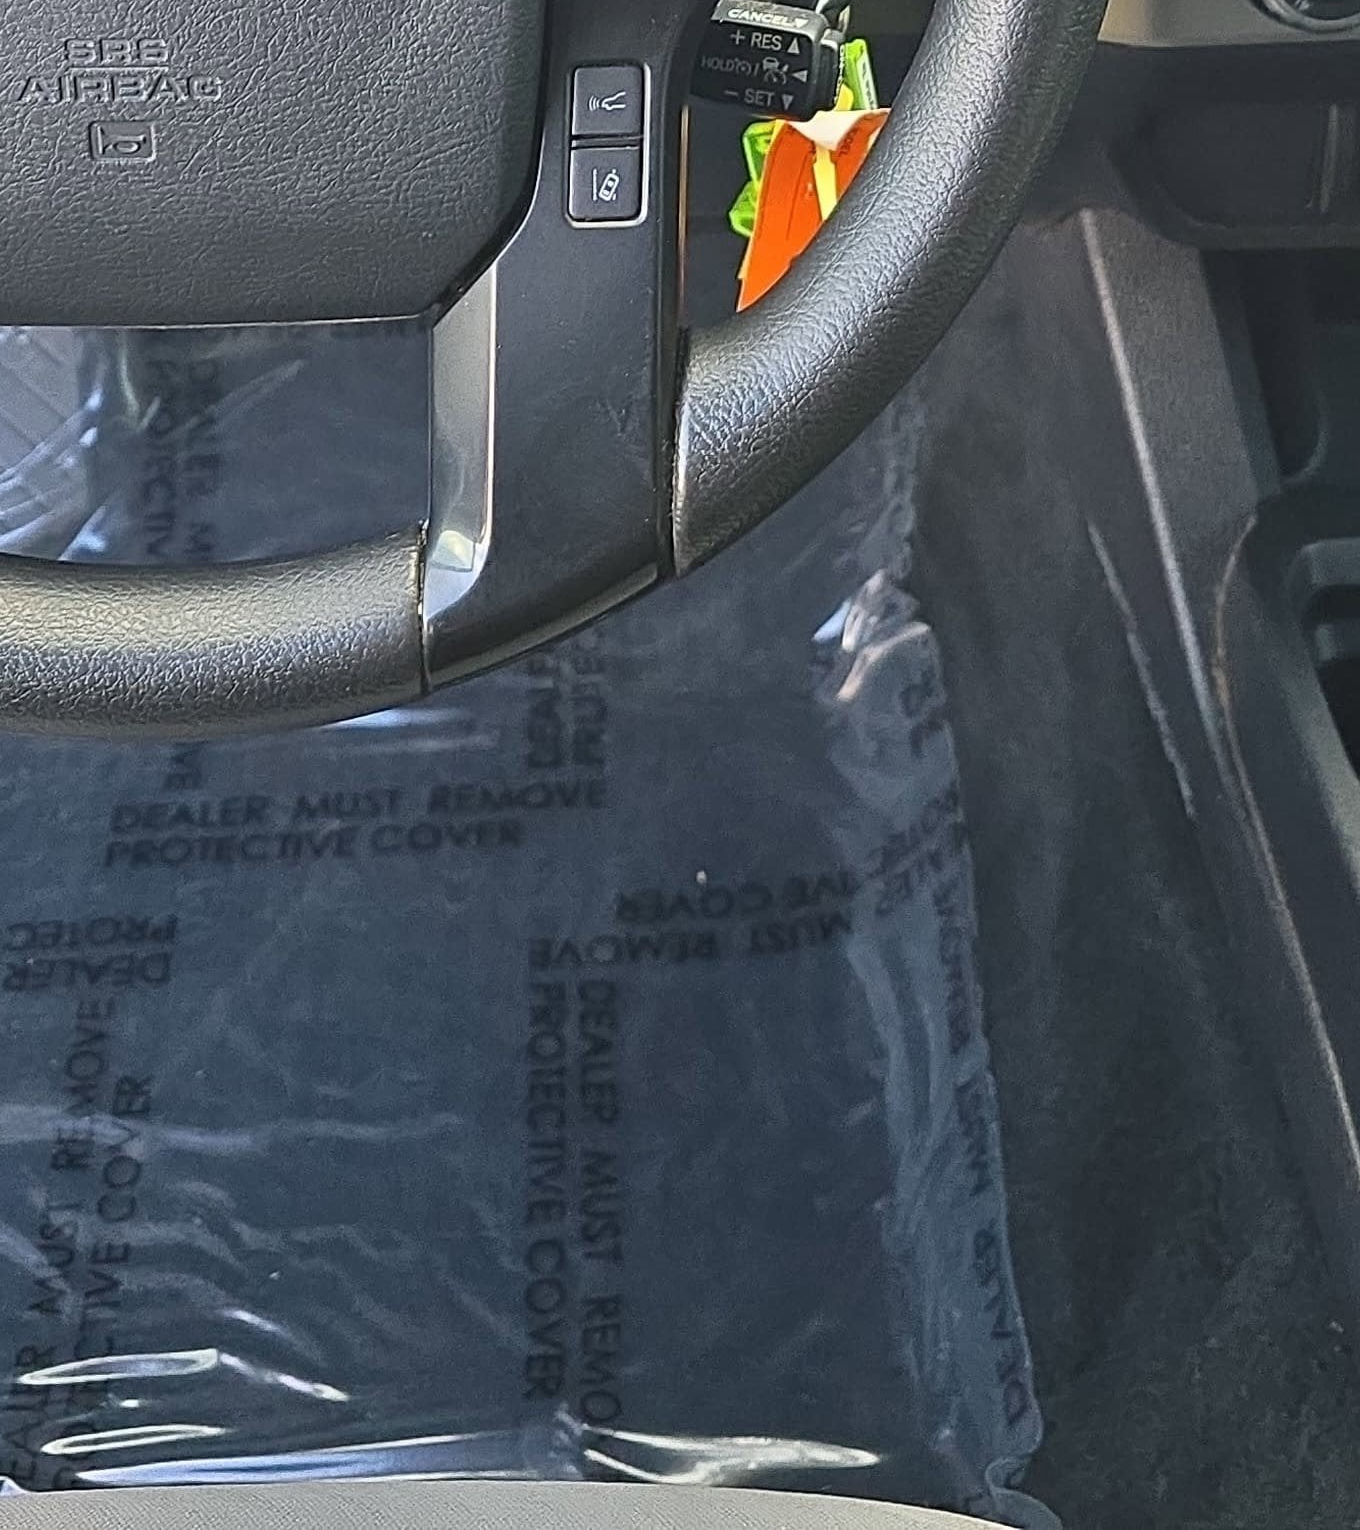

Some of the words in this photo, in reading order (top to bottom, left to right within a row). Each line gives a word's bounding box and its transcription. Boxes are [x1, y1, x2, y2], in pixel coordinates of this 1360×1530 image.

[727, 7, 794, 27] CANCEL
[64, 37, 169, 65] SRS
[751, 32, 782, 51] RES
[17, 74, 223, 103] AIRBAG
[744, 88, 777, 107] SET
[110, 795, 272, 835] DEALER
[291, 788, 401, 822] MUST
[427, 779, 609, 815] REMOVE
[101, 825, 361, 869] PROTECTIVE
[372, 817, 523, 855] COVER
